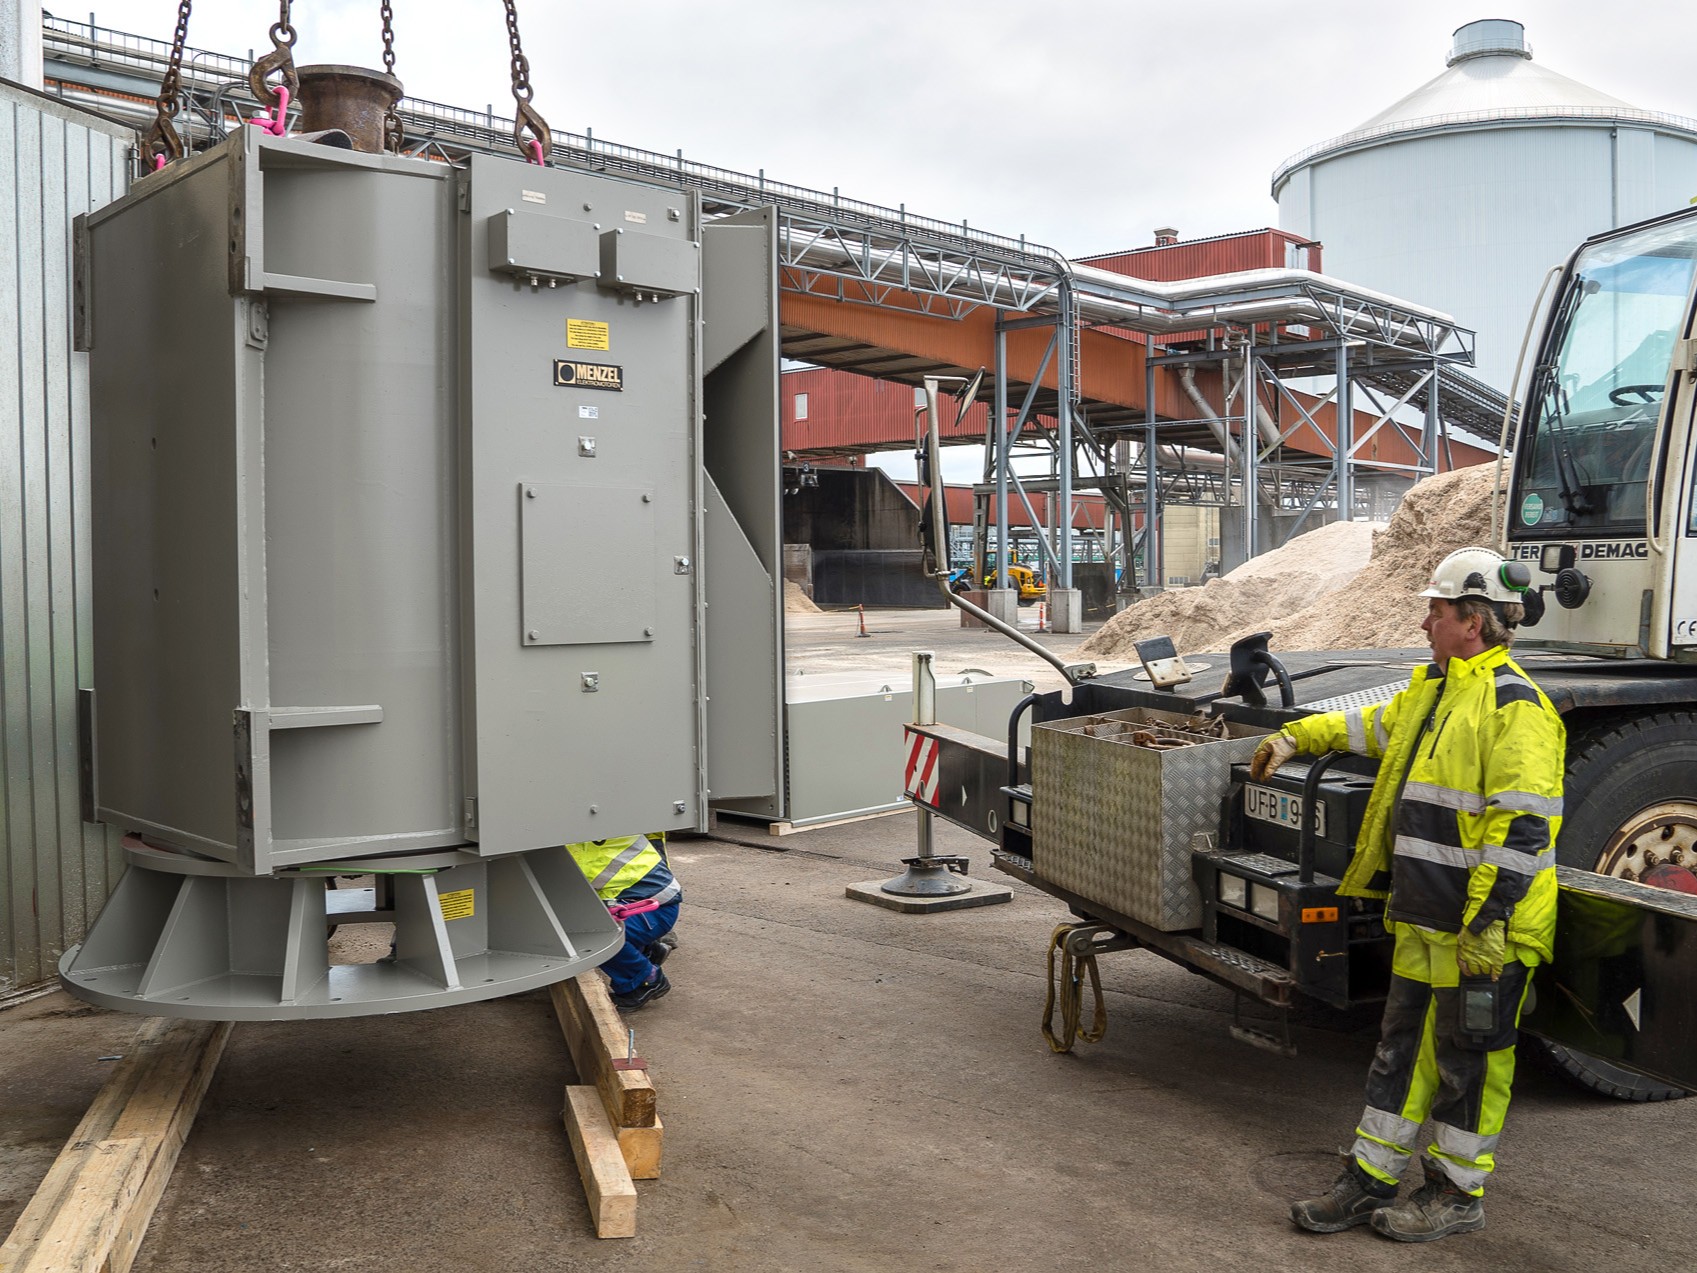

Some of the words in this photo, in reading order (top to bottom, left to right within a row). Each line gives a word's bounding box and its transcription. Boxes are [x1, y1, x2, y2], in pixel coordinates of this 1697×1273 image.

[576, 363, 621, 383] MENZEL
[803, 463, 810, 472] 3
[1581, 542, 1649, 559] DEMAG
[1290, 799, 1321, 832] 96
